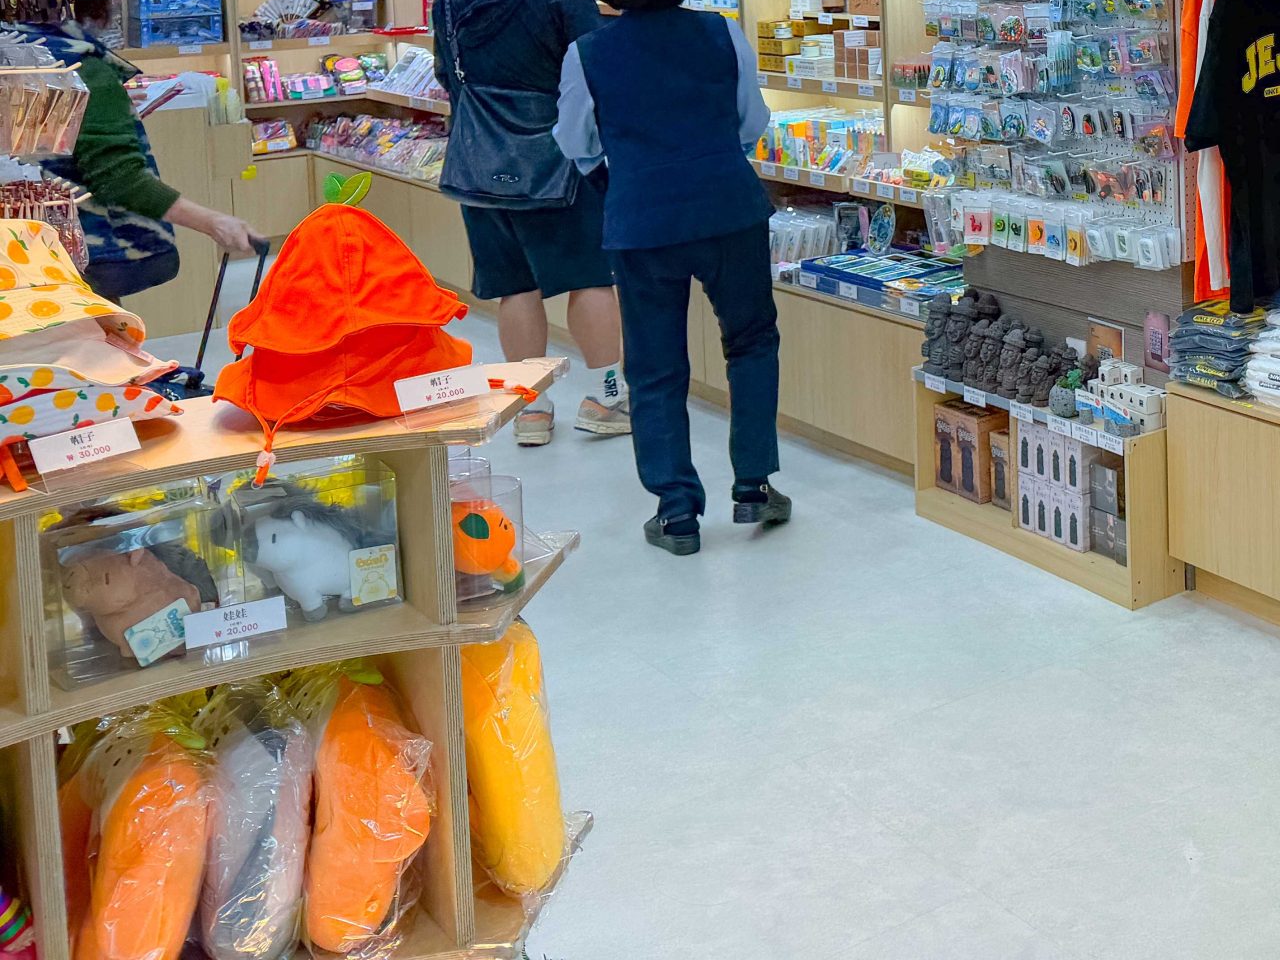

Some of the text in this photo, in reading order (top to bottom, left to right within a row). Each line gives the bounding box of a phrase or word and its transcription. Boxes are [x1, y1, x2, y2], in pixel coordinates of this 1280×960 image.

[429, 374, 453, 388] 帽子
[436, 387, 465, 400] 20,000
[69, 430, 95, 446] 帽子
[78, 444, 111, 459] 30,000
[223, 607, 248, 622] 娃娃
[226, 622, 259, 636] 20,000
